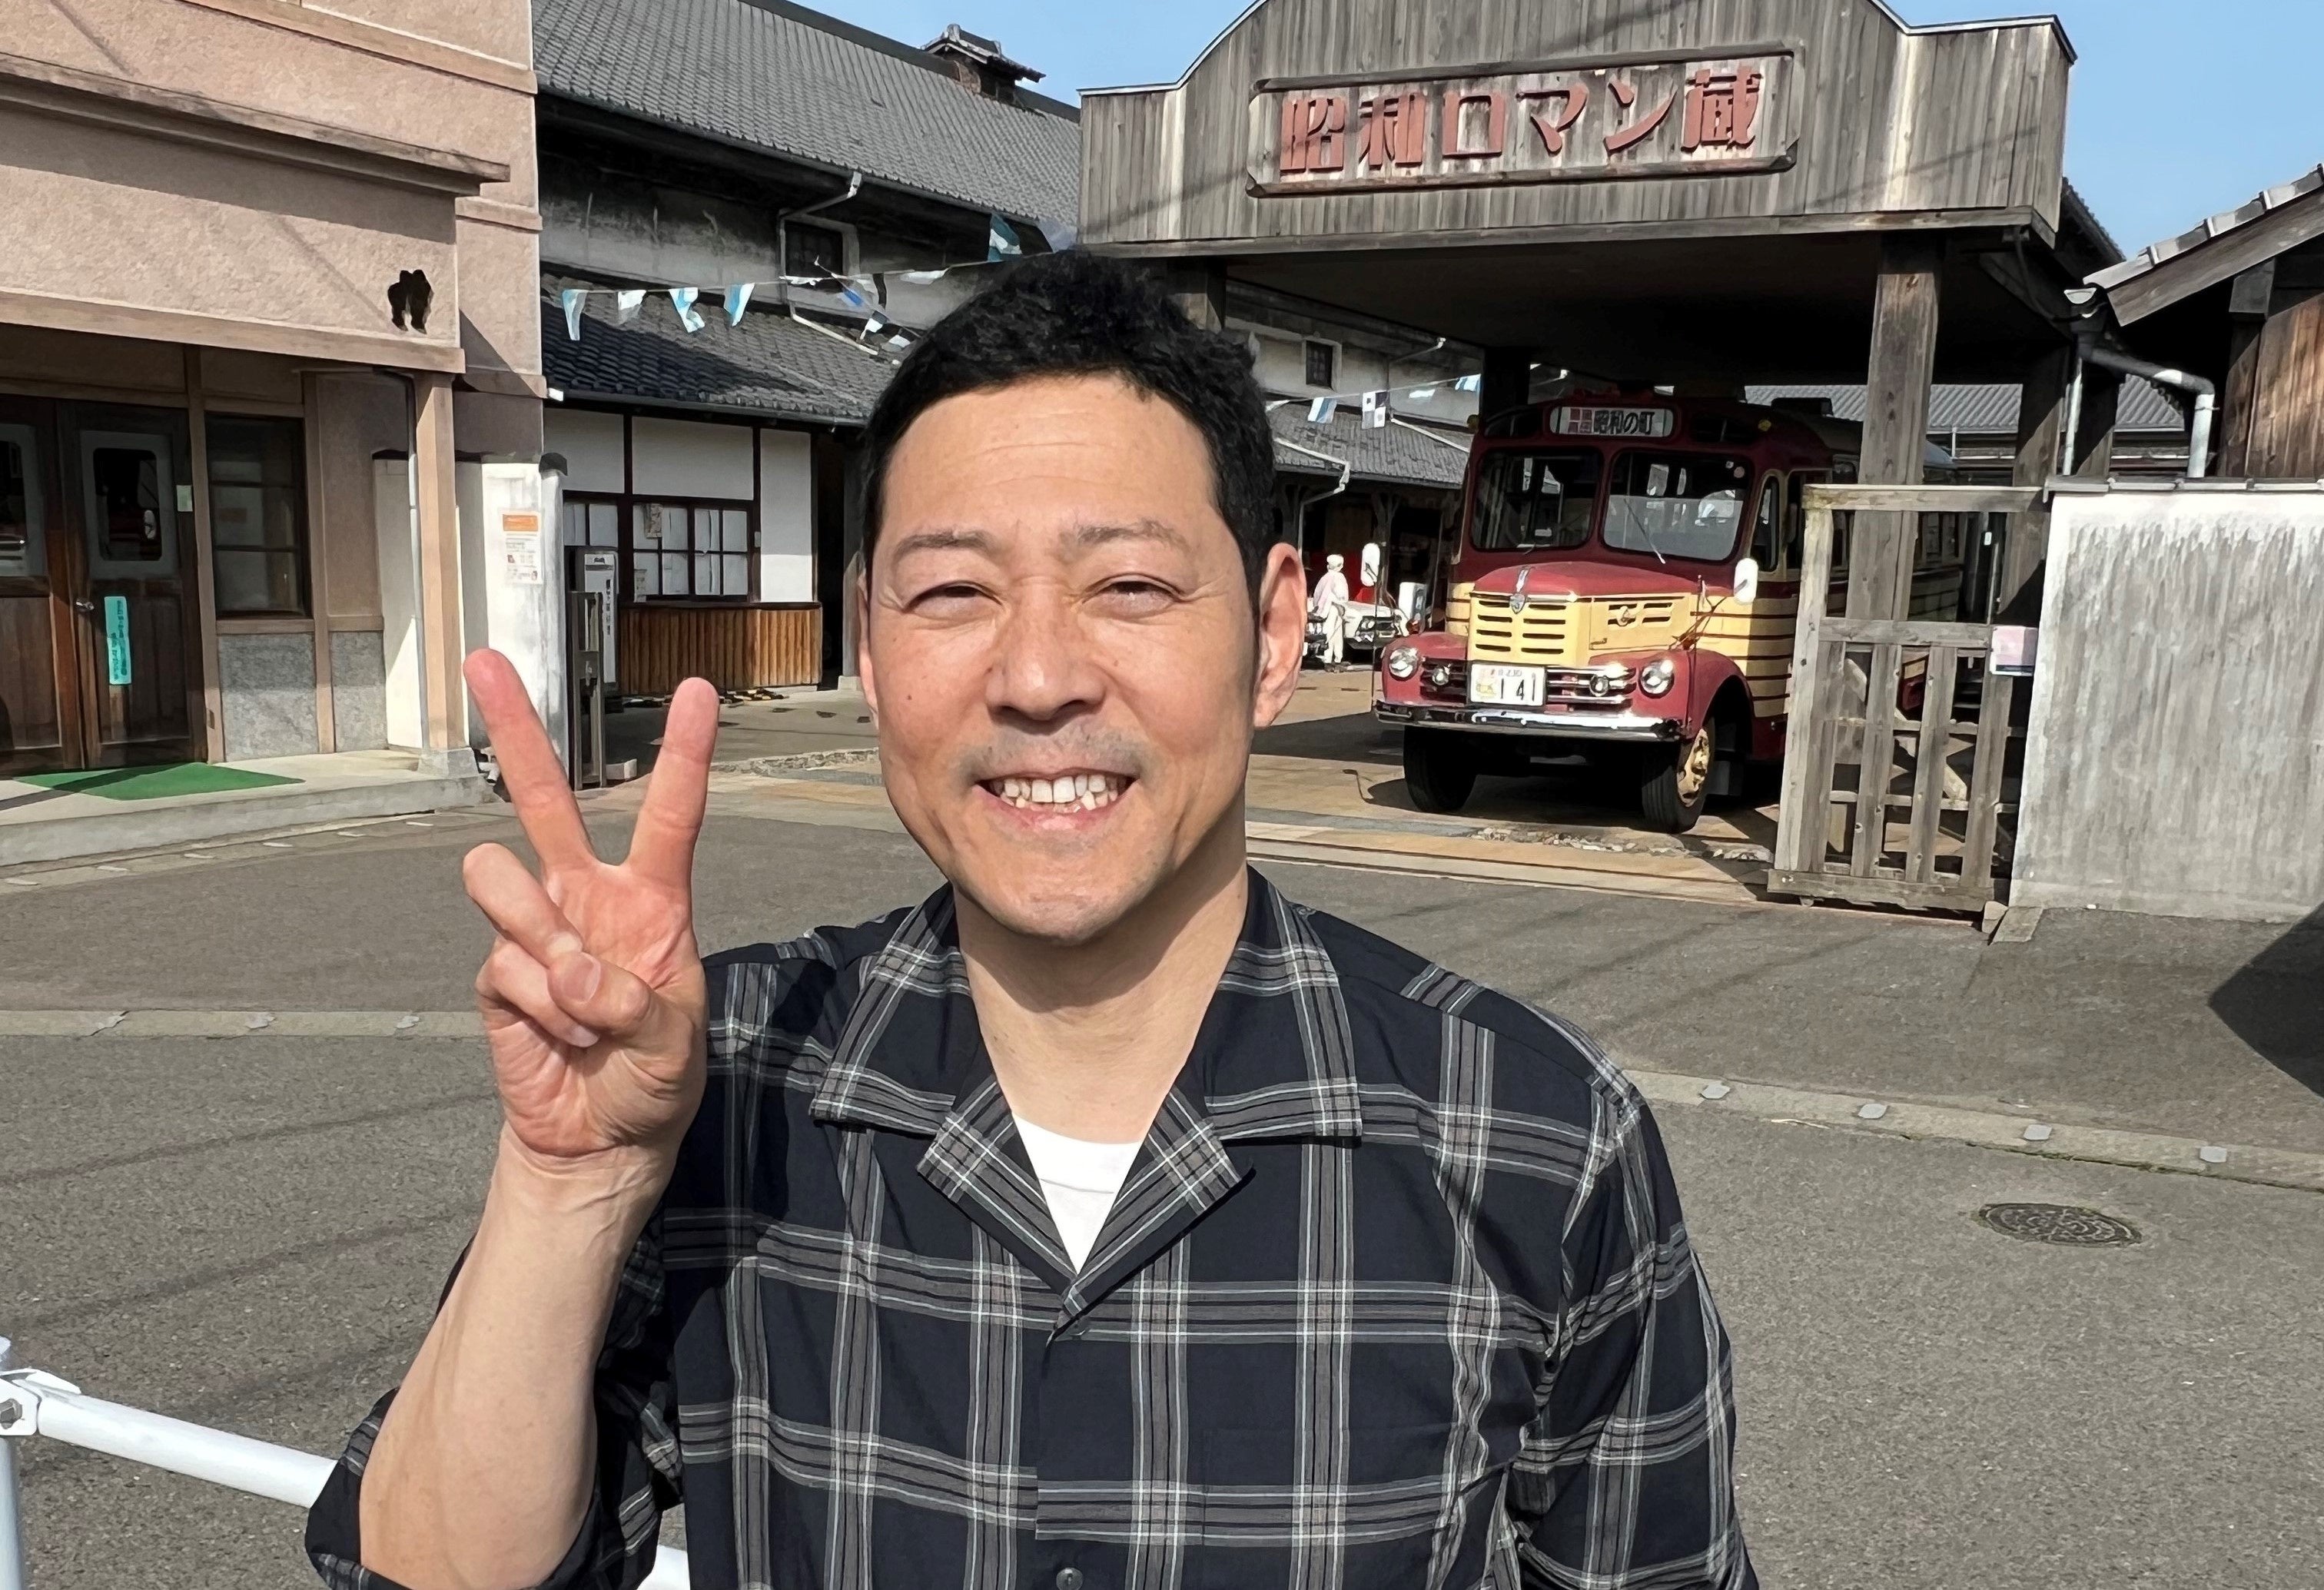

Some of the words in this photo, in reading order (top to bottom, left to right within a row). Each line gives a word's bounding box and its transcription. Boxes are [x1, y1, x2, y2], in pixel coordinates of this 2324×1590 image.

[1280, 68, 1763, 172] 昭和ロマン蔵
